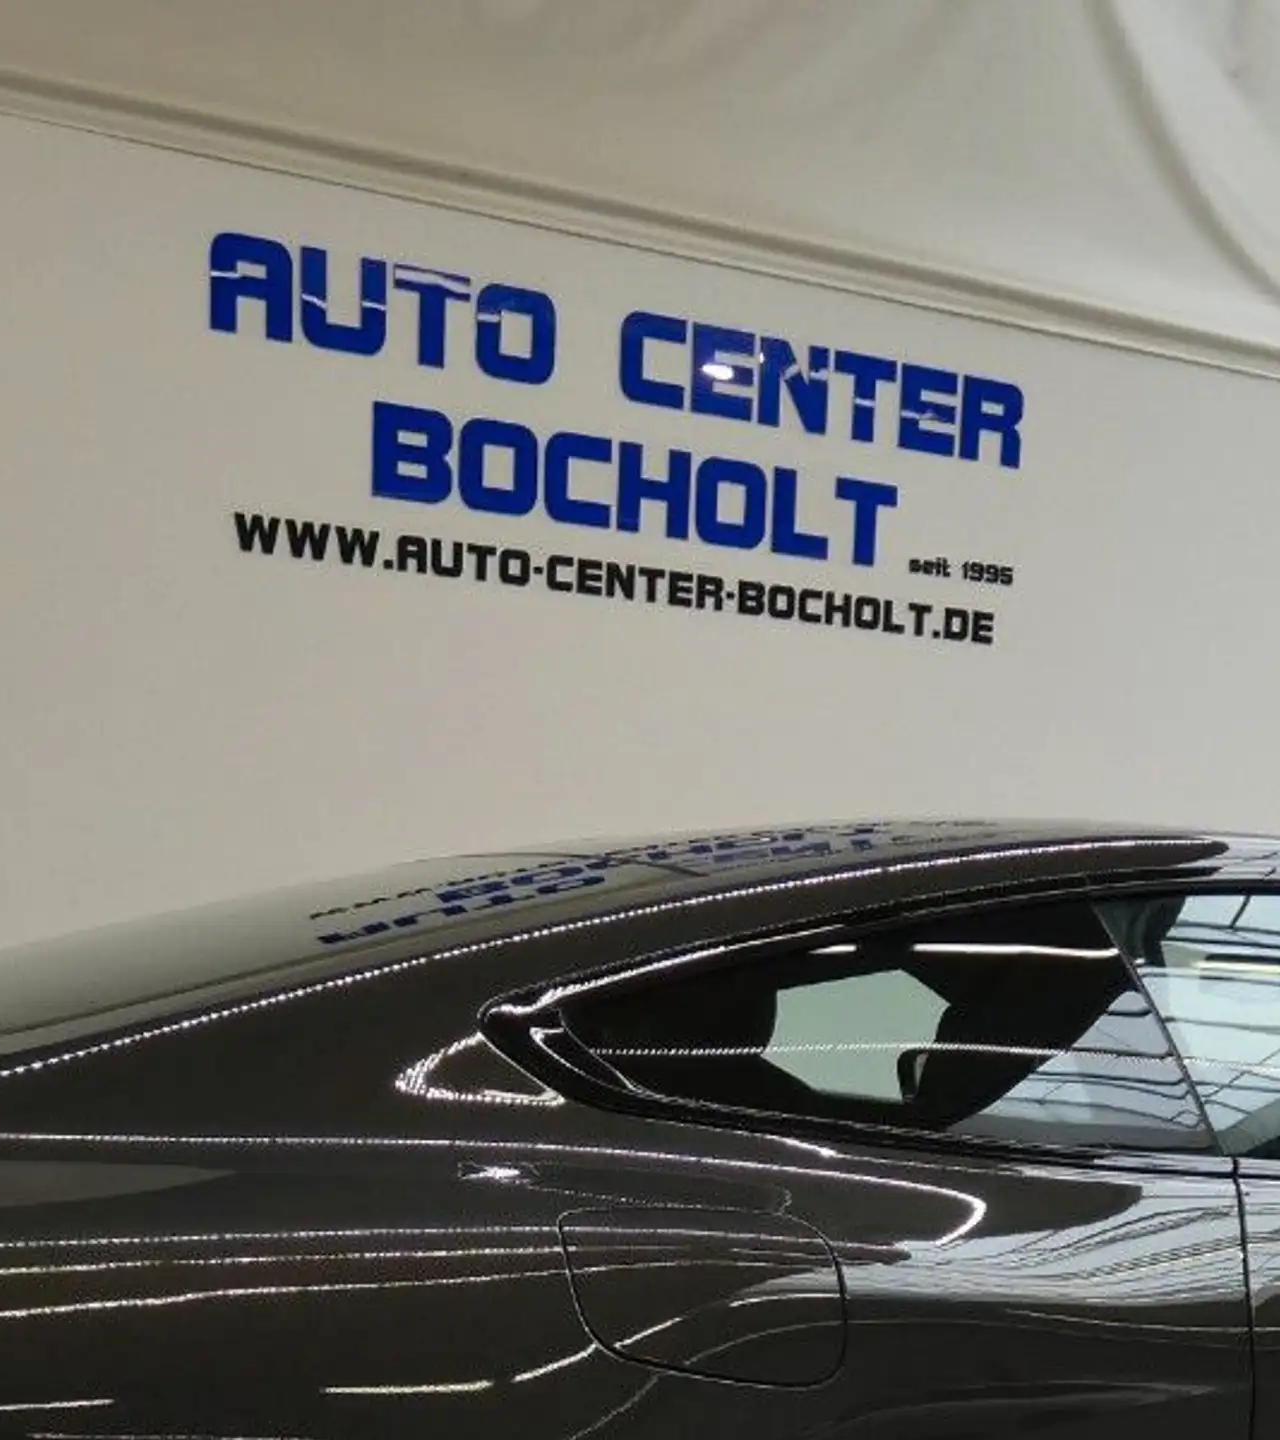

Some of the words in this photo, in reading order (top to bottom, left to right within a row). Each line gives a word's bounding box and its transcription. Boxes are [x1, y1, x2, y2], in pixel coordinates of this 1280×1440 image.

[210, 233, 557, 385] AUTO
[620, 312, 1024, 467] CENTER
[372, 403, 898, 566] BOCHOLT
[234, 511, 995, 645] WWW.AUTO-CENTER-BOCHOLT.DE
[962, 561, 1014, 586] 1995
